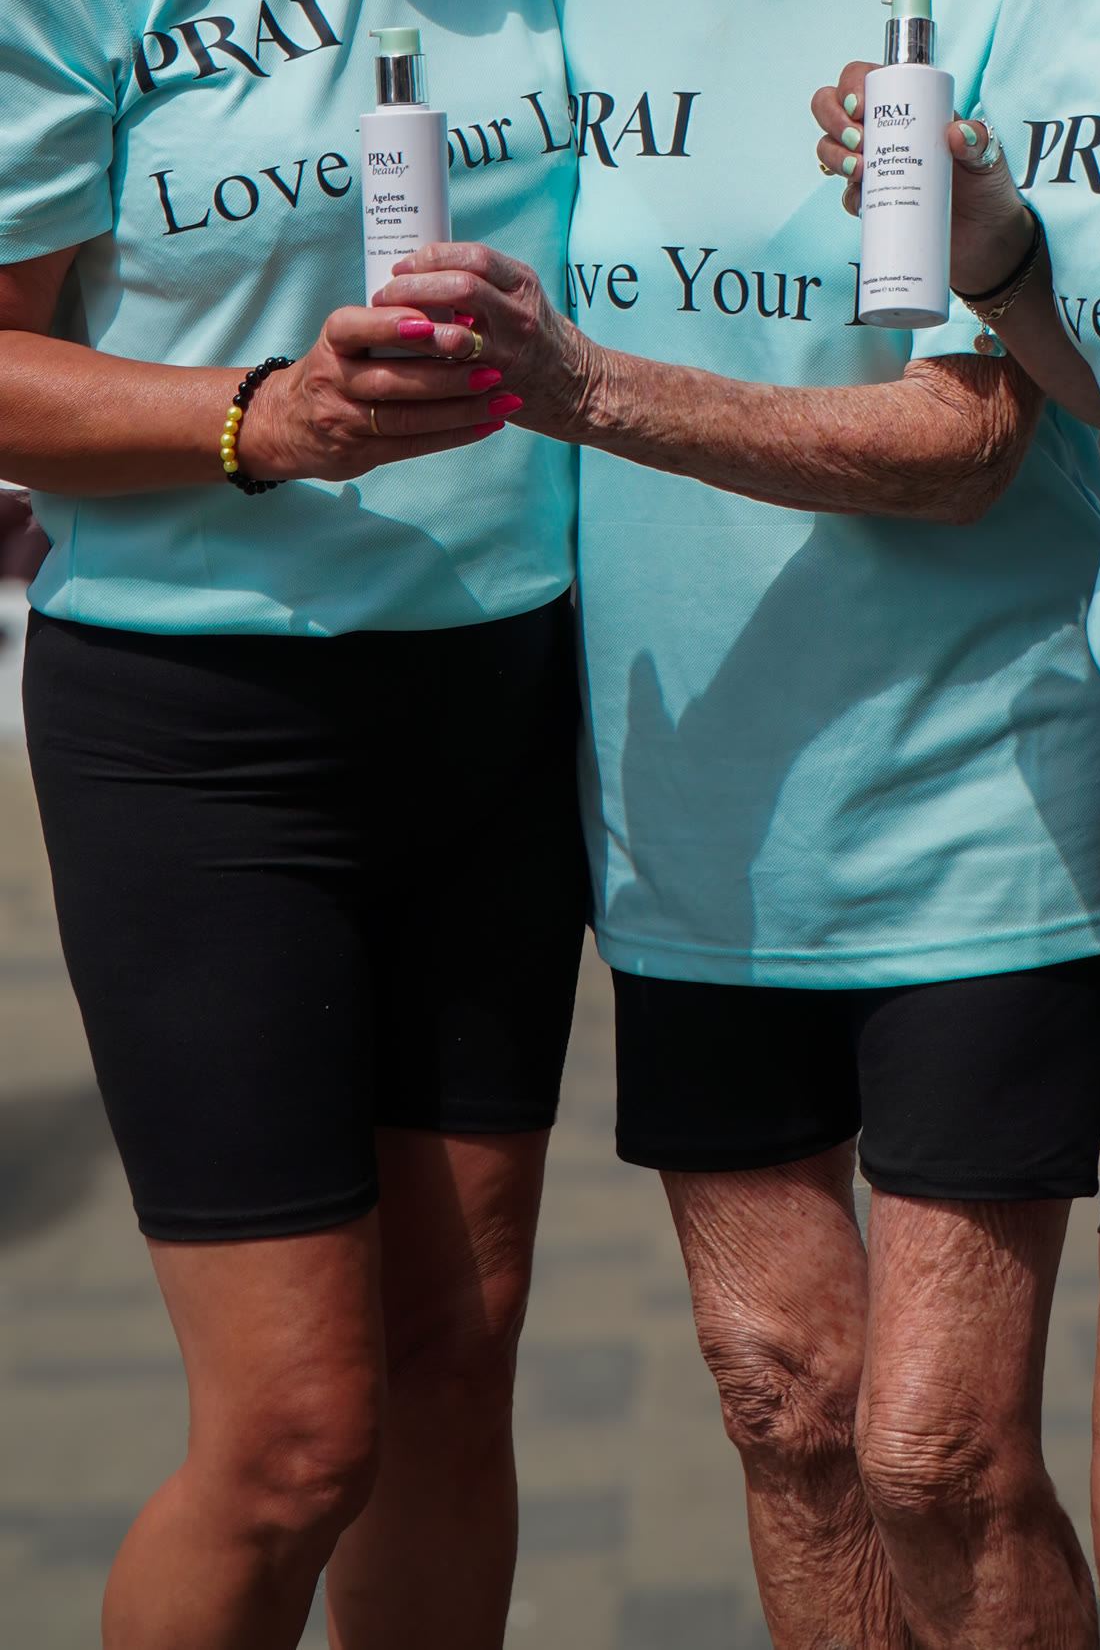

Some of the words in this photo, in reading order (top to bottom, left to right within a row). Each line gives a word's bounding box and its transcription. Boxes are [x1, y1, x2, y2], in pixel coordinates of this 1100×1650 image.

[873, 103, 911, 119] PRAI
[875, 144, 910, 156] Ageless
[368, 151, 403, 167] PRAI
[878, 156, 923, 166] Perfecting
[877, 169, 905, 177] Serum
[149, 152, 352, 236] Love
[372, 193, 405, 204] Ageless
[375, 204, 419, 214] Perfecting
[375, 217, 402, 225] Serum
[567, 263, 639, 309] ove
[661, 246, 822, 321] Your
